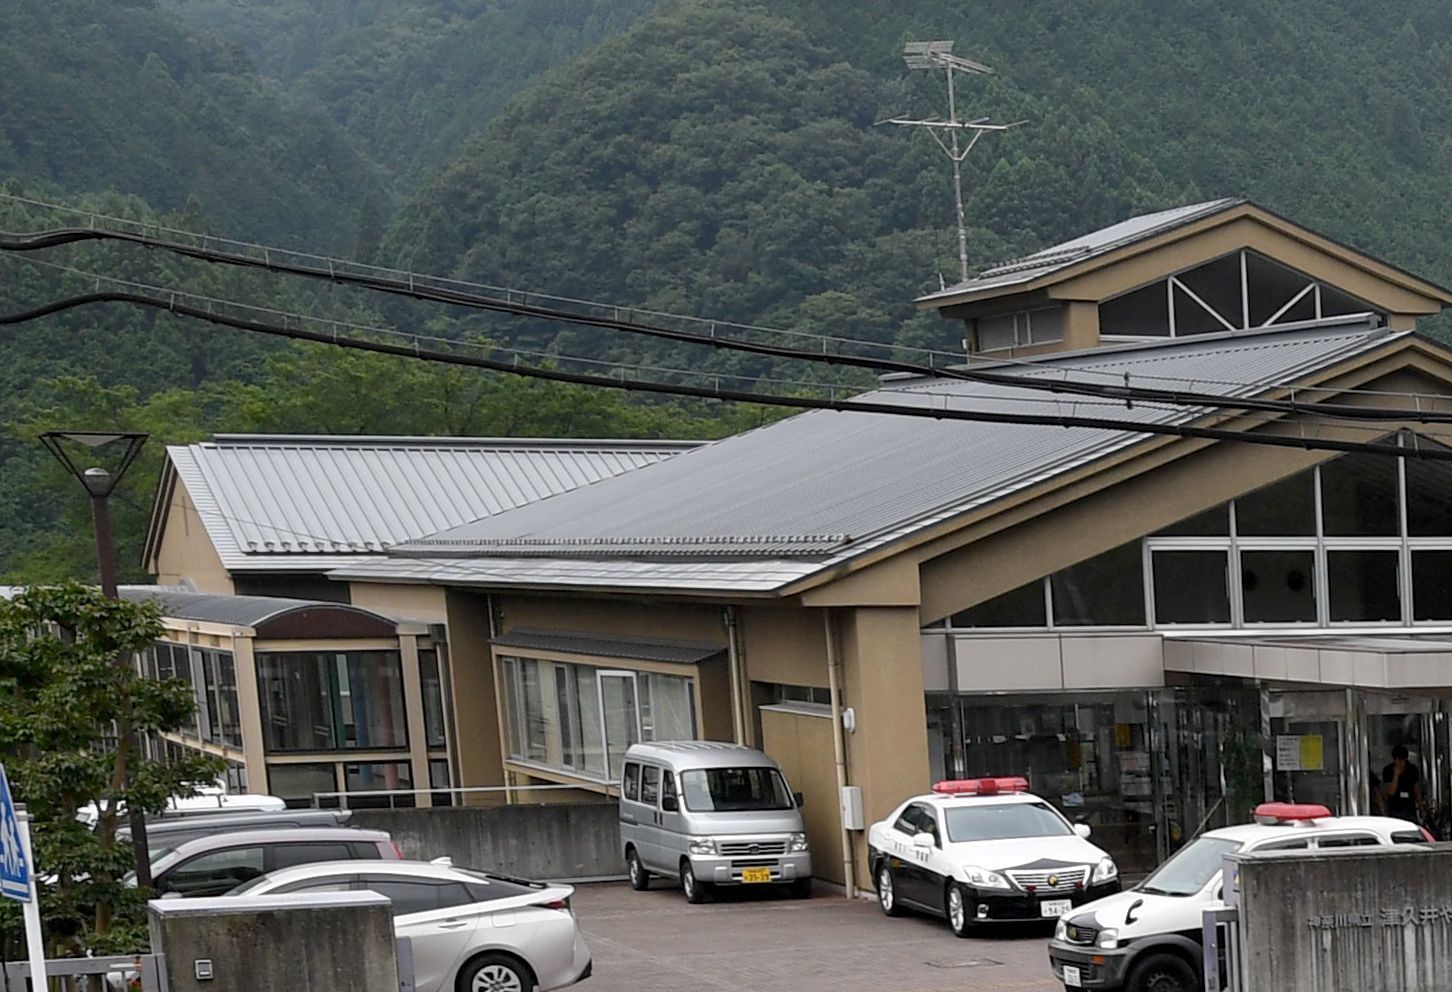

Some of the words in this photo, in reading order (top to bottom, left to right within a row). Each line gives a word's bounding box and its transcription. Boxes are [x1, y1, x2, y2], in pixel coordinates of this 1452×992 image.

[1308, 913, 1375, 929] 神奈川県立
